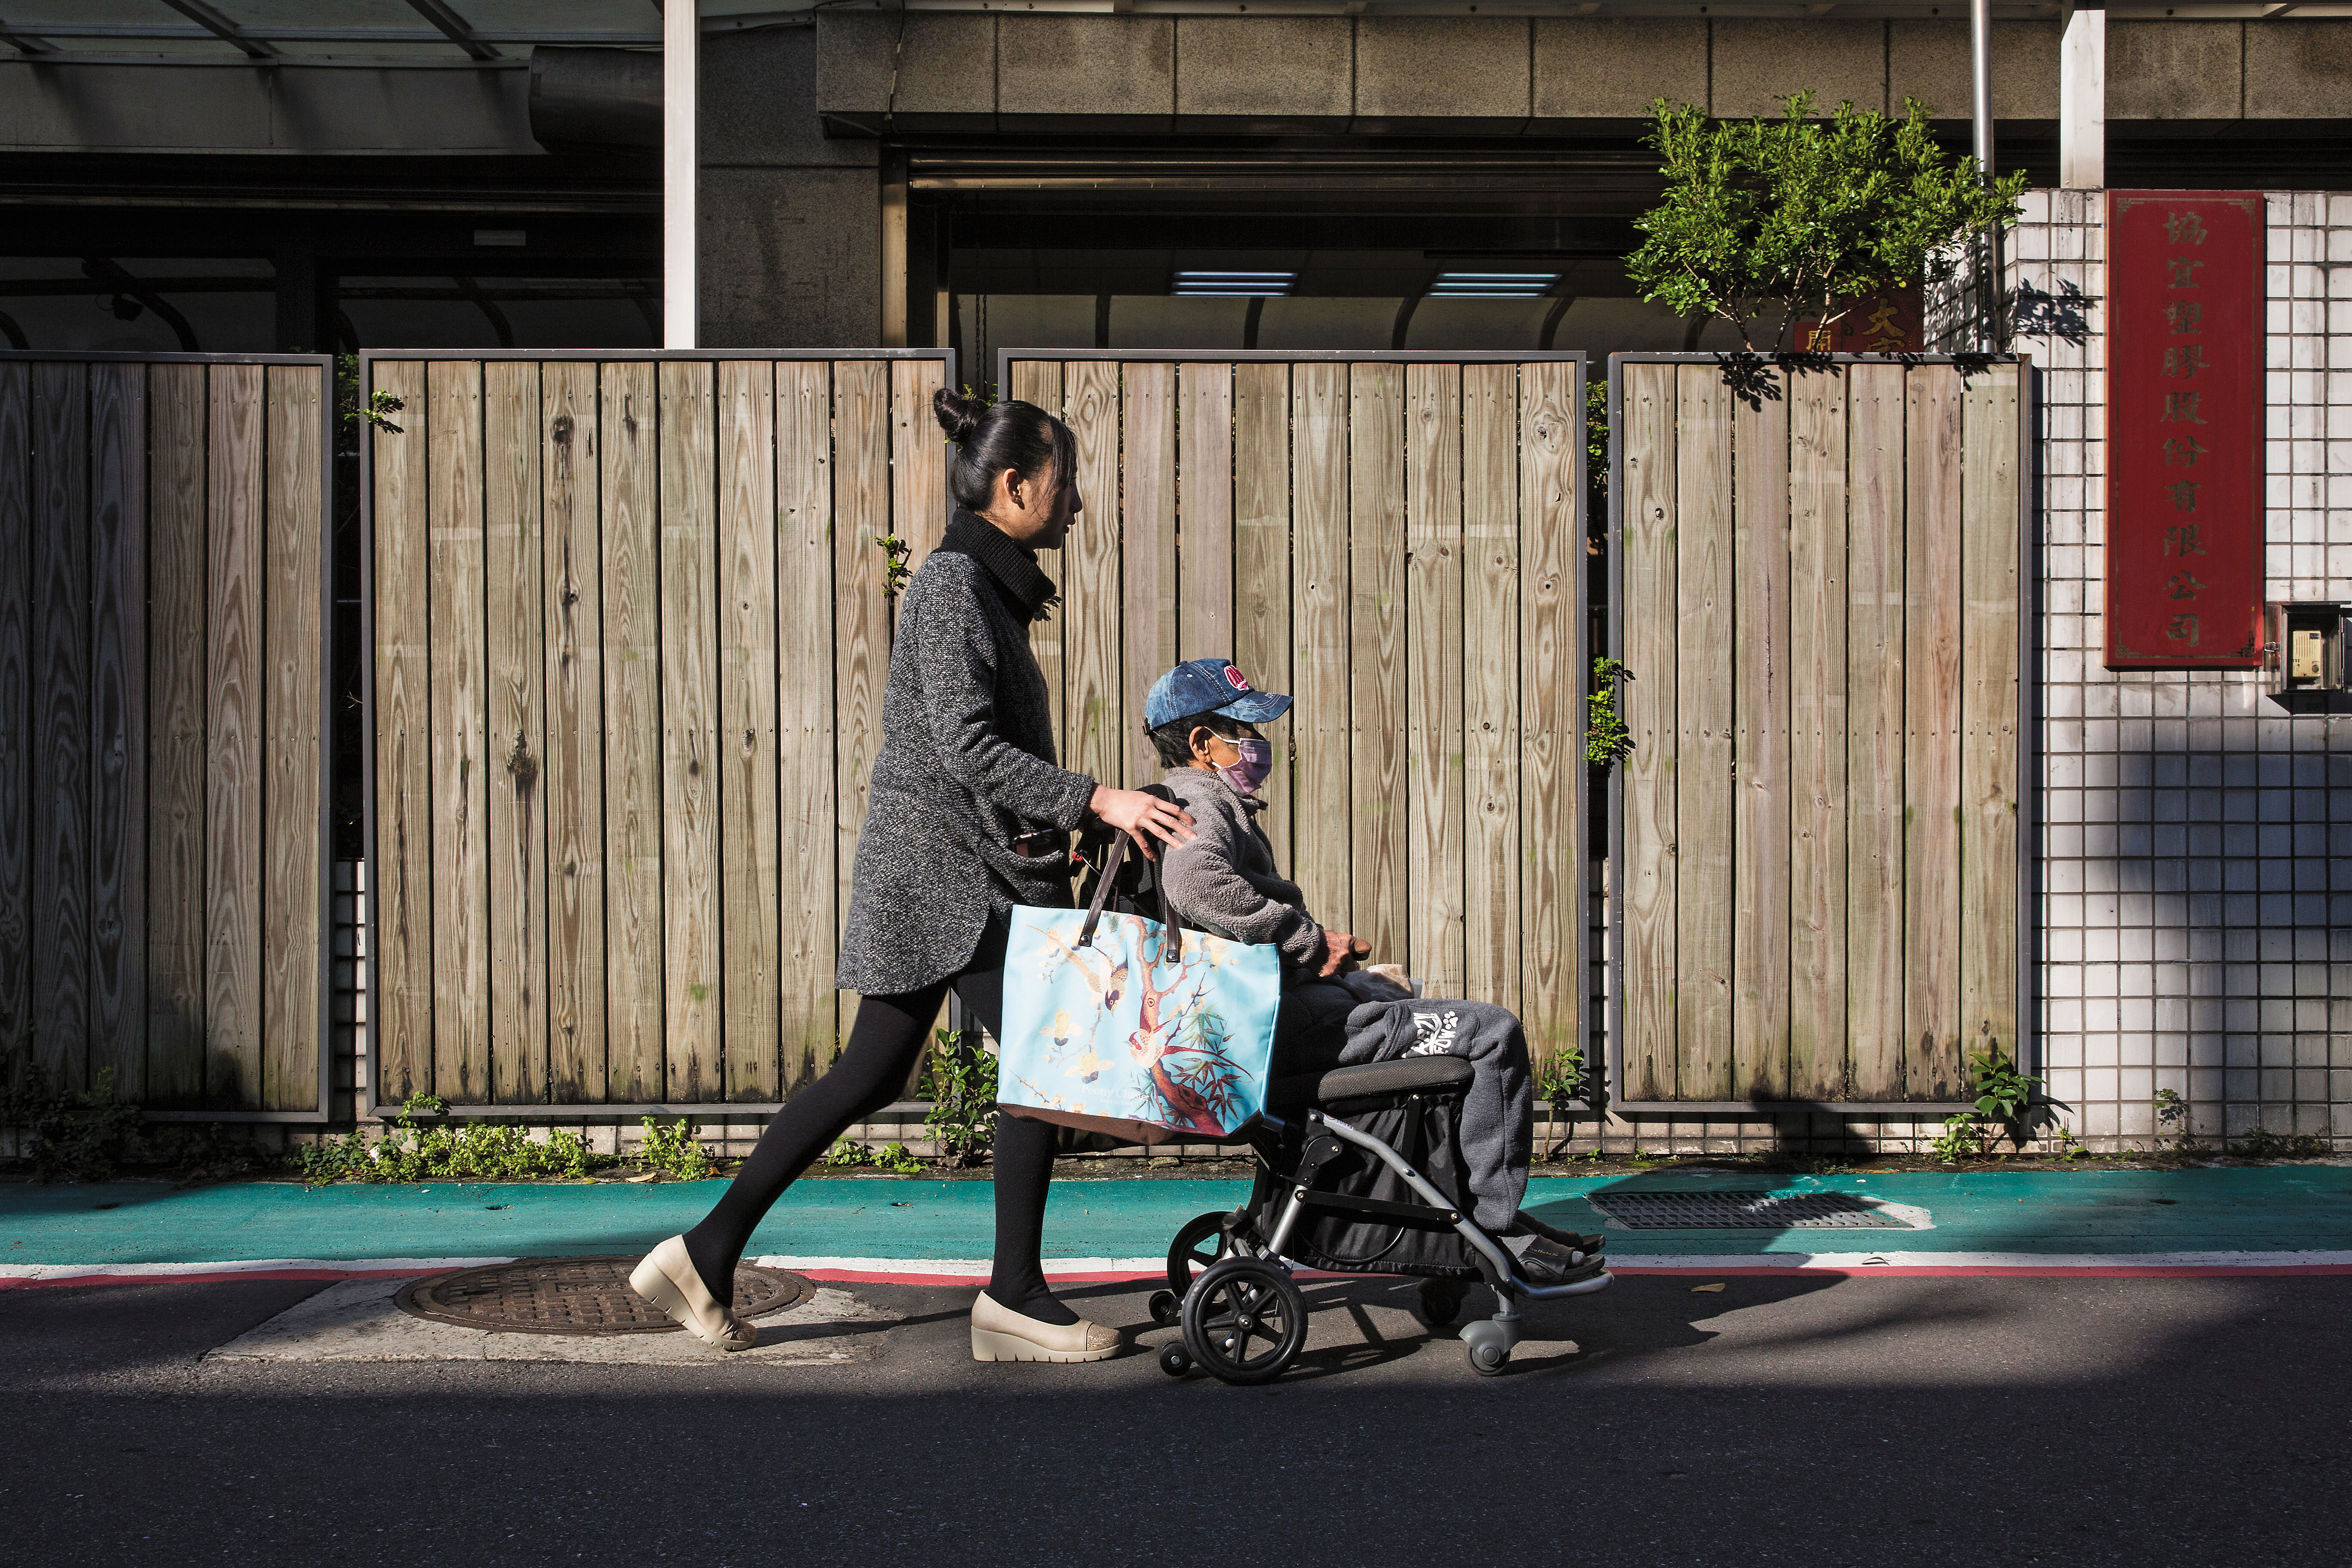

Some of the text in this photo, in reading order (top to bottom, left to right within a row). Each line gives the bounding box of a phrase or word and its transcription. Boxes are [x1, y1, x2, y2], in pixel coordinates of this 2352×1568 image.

[2160, 211, 2210, 647] 協宜塑膠股份有限公司
[1082, 1084, 1114, 1097] Peony
